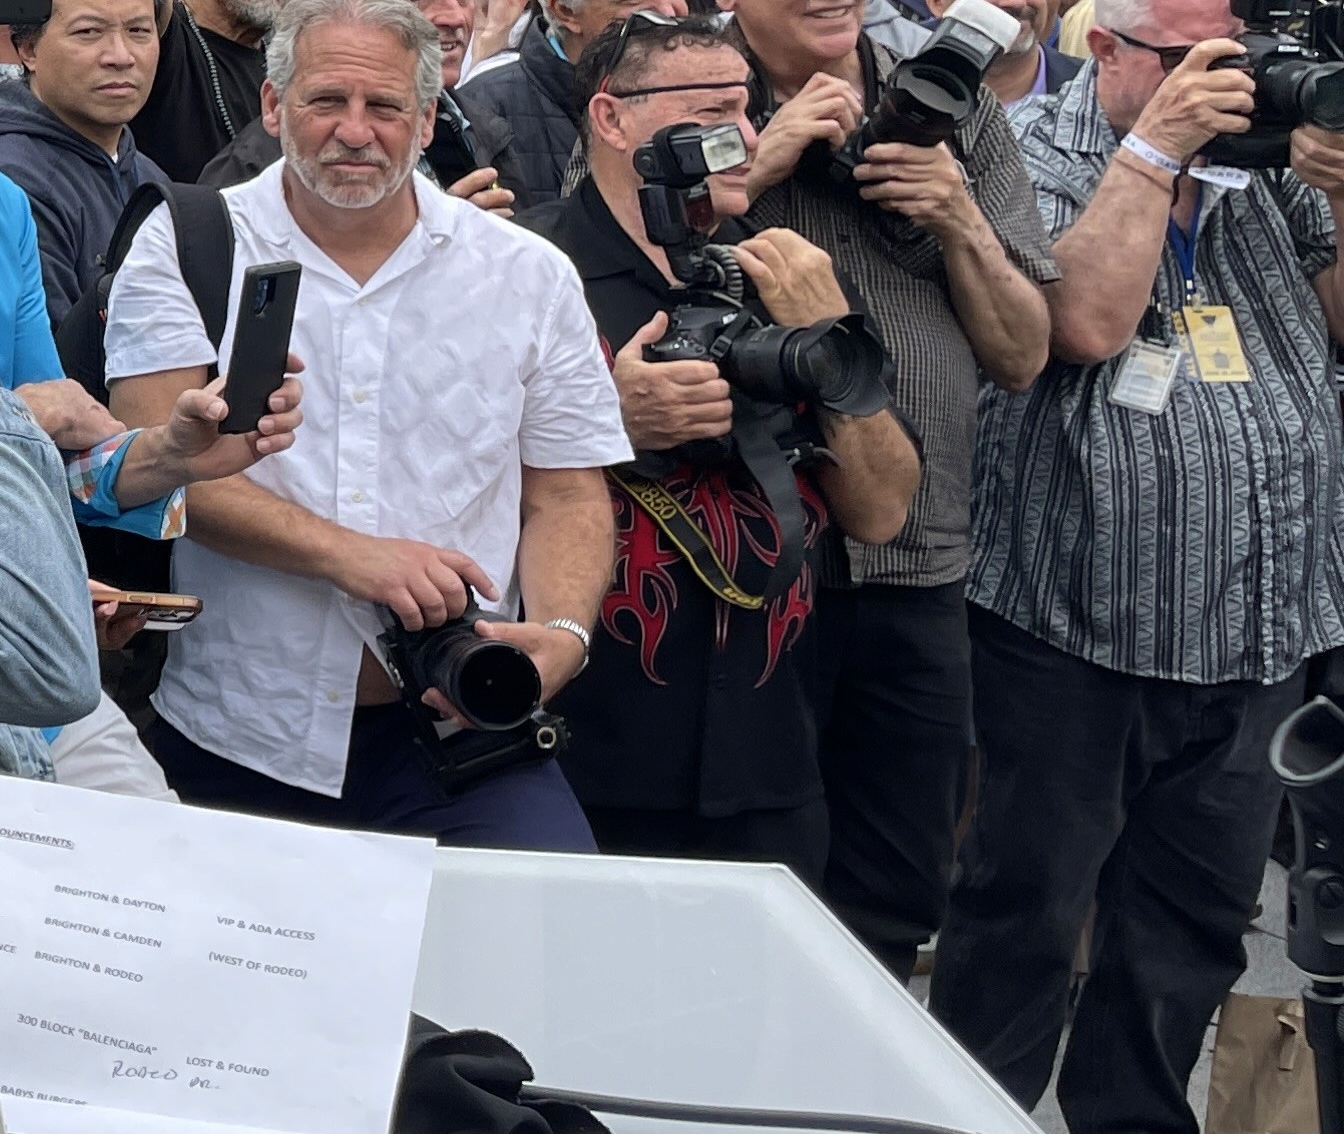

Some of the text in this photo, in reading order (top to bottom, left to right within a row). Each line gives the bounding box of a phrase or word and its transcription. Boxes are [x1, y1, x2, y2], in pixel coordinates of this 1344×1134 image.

[54, 884, 166, 913] BRIGHTON & DAYTON
[44, 917, 162, 948] BRIGHTON & CAMDEN
[216, 915, 316, 941] VIP & ADA ACCESS
[34, 951, 143, 983] BRIGHTON & RODEO
[208, 951, 308, 980] (WEST OF RODEO)
[16, 1013, 158, 1055] 300 BLOCK "BALENCIAGA"
[185, 1056, 270, 1077] LOST & FOUND
[0, 1084, 34, 1100] BABYS
